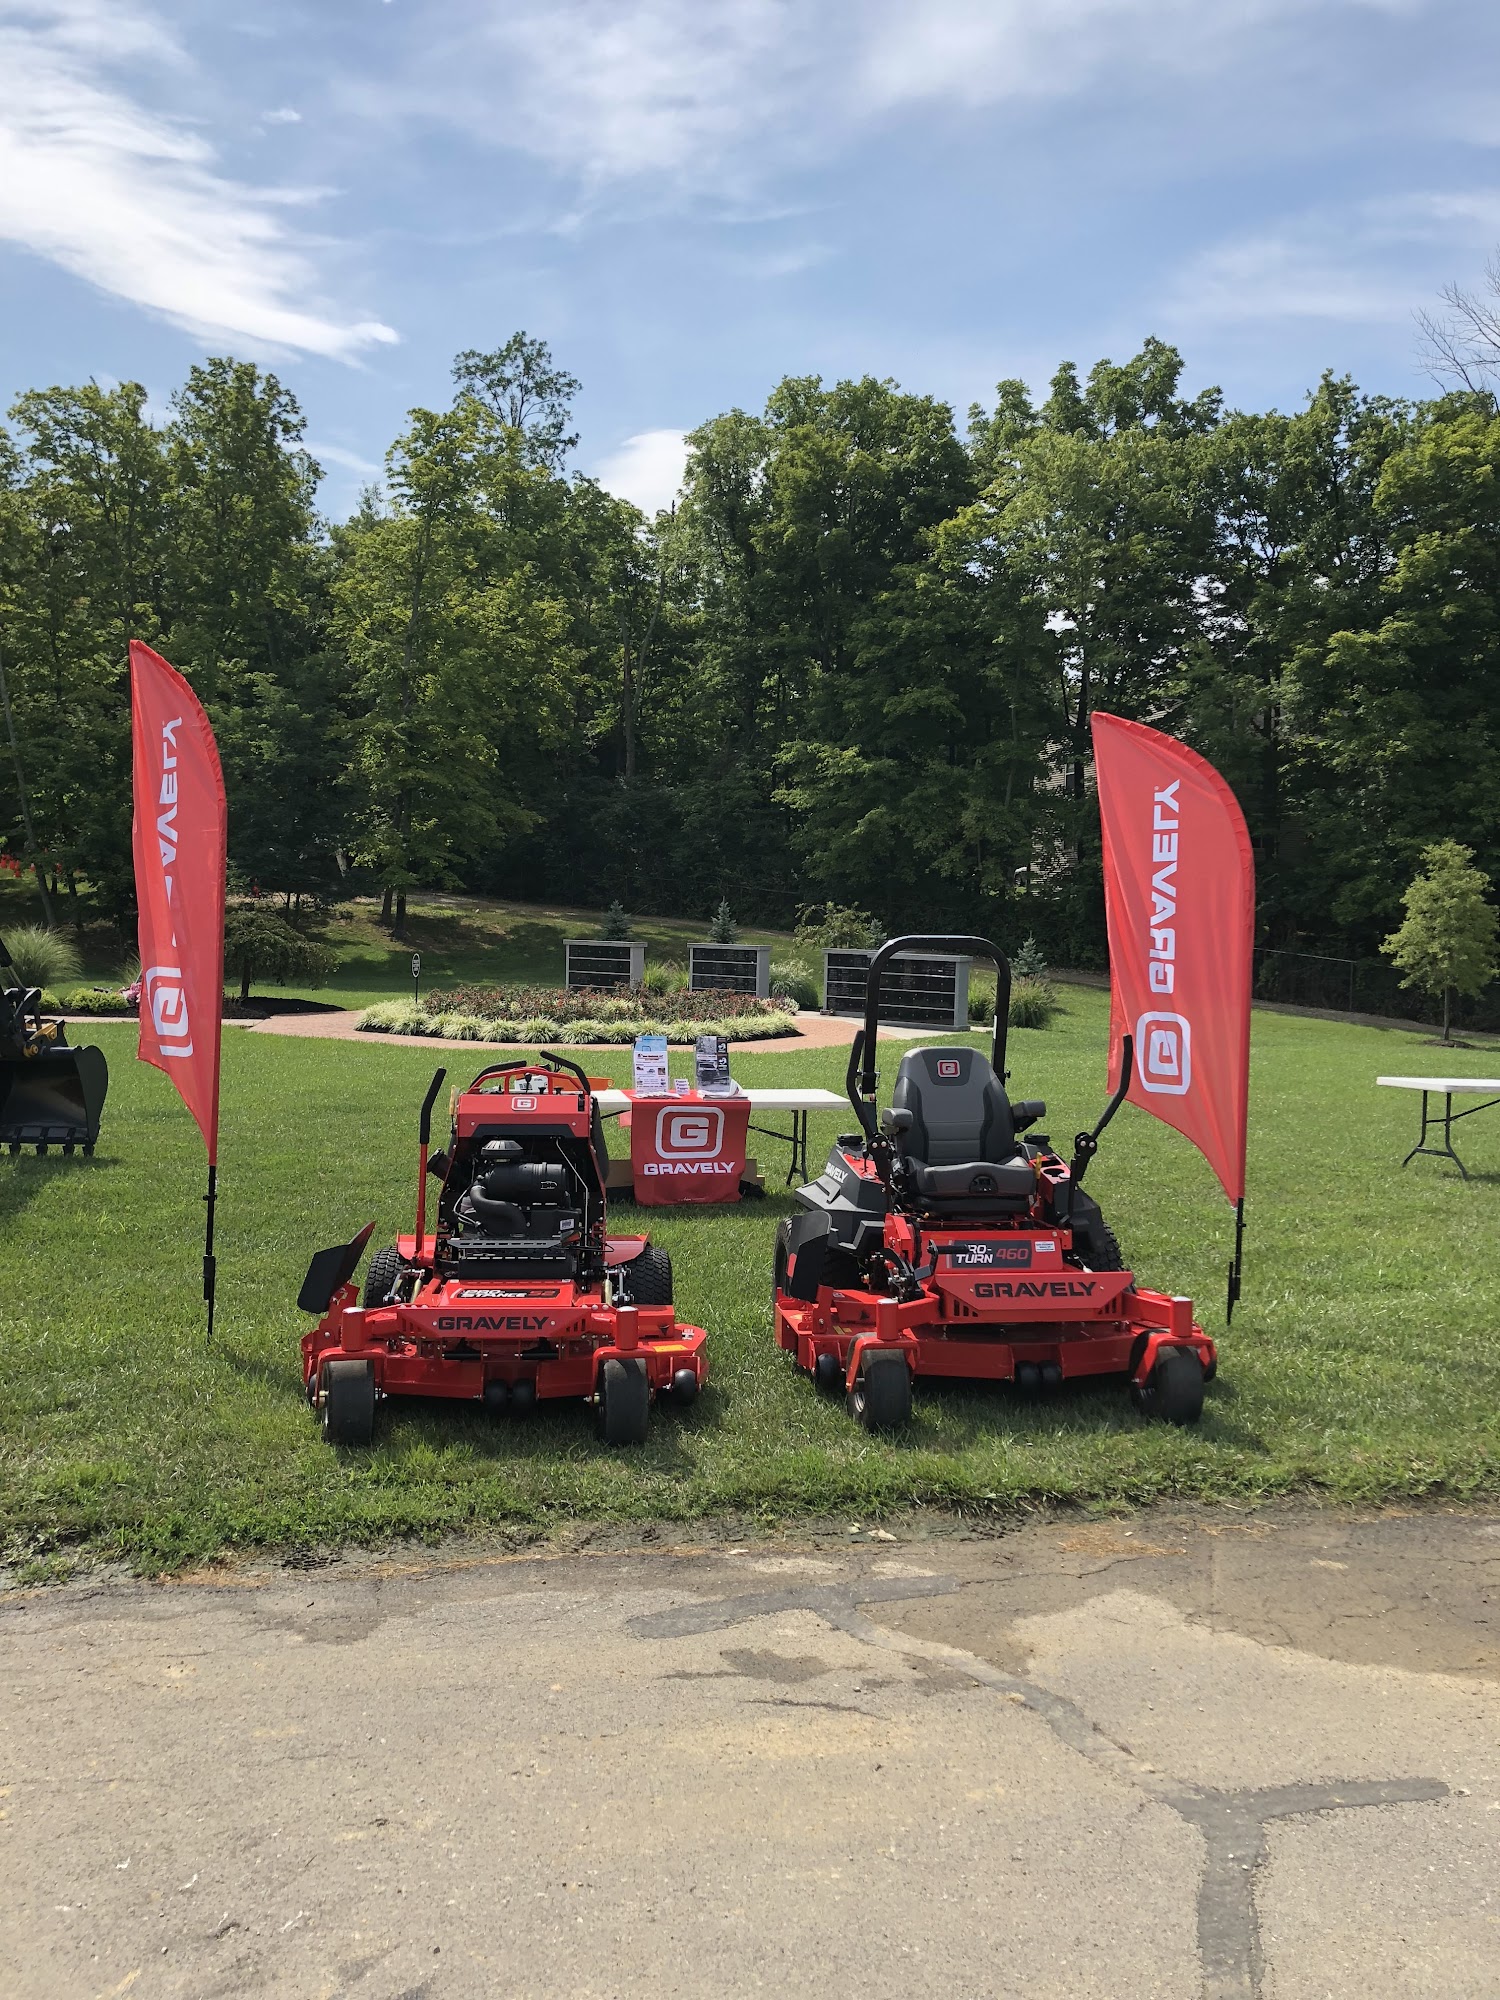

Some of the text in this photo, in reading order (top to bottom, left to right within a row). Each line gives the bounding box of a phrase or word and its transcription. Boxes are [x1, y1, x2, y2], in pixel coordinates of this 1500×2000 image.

[670, 1116, 709, 1147] G
[643, 1161, 735, 1175] GRAVELY
[968, 1245, 992, 1254] RO-
[996, 1249, 1028, 1259] 460
[956, 1254, 993, 1263] TURN
[975, 1282, 1096, 1297] GRAVELY
[440, 1317, 548, 1330] GRAVELY
